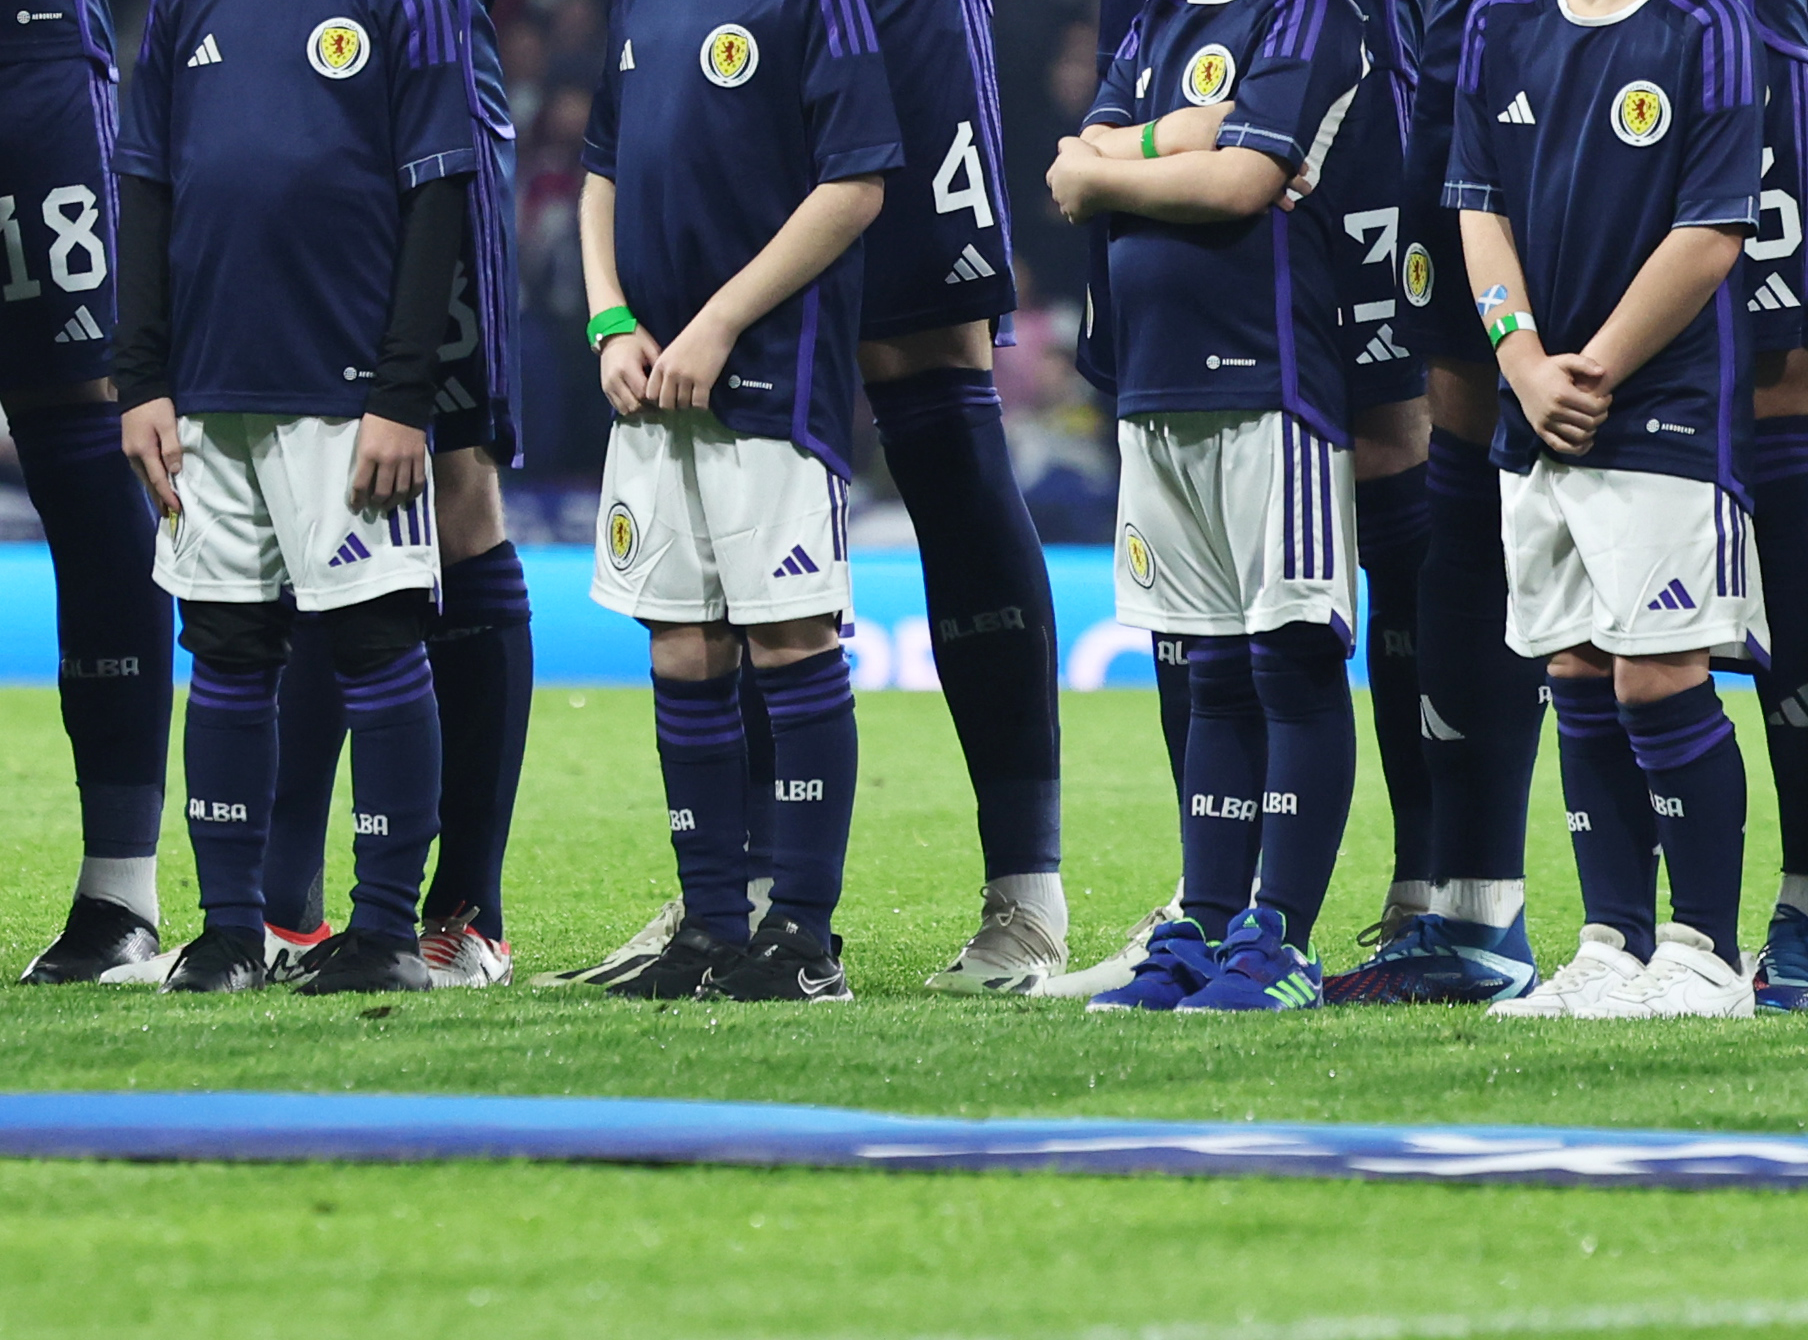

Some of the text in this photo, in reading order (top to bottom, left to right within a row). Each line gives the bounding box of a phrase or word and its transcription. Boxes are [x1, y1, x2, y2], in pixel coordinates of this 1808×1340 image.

[932, 120, 994, 229] 4
[1158, 640, 1191, 665] AL
[189, 797, 247, 822] ALBA
[1191, 793, 1258, 822] ALBA
[1262, 791, 1297, 815] LBA
[1649, 790, 1685, 817] LBA
[353, 812, 389, 836] LBA
[668, 808, 696, 831] BA
[1566, 811, 1592, 832] BA
